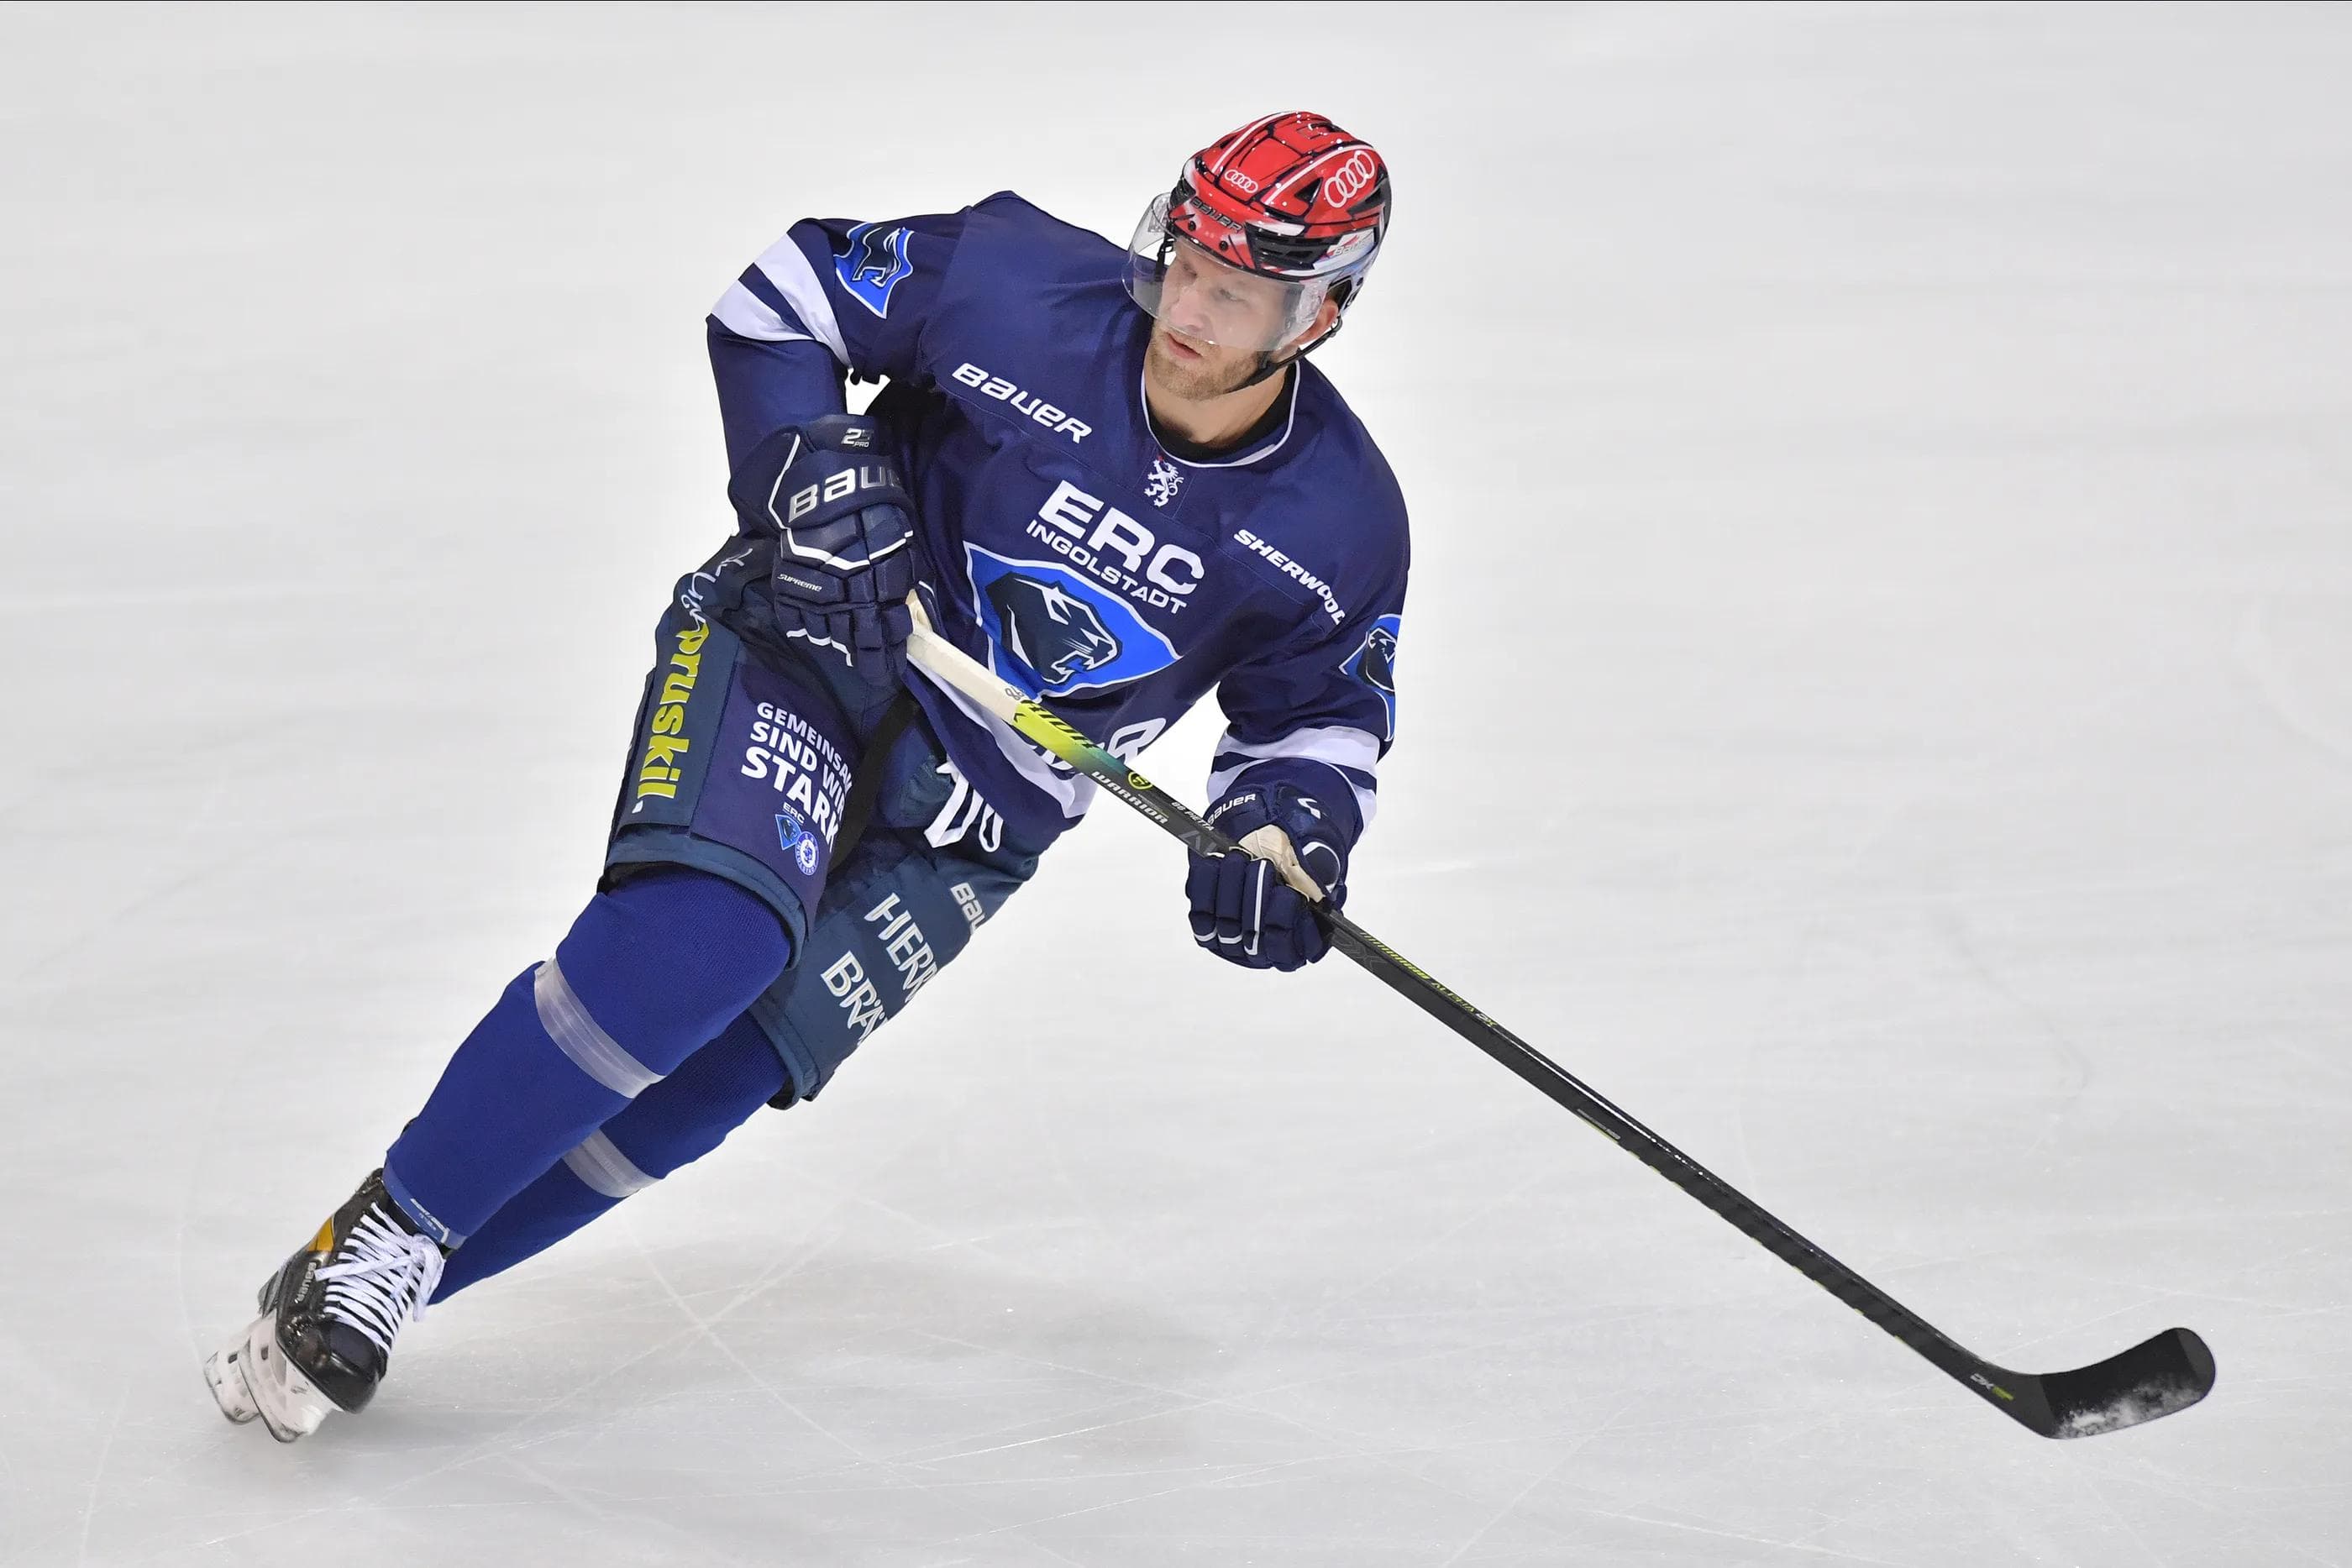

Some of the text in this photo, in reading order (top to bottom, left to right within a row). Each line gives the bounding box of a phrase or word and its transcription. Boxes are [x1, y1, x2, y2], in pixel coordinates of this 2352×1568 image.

[789, 466, 900, 522] BAU
[1038, 480, 1205, 595] ERC
[1026, 519, 1187, 614] INGOLSTADT
[750, 721, 817, 772] SIND
[741, 746, 838, 853] STARK
[783, 802, 805, 824] ERC
[1091, 771, 1168, 825] WARRIOR
